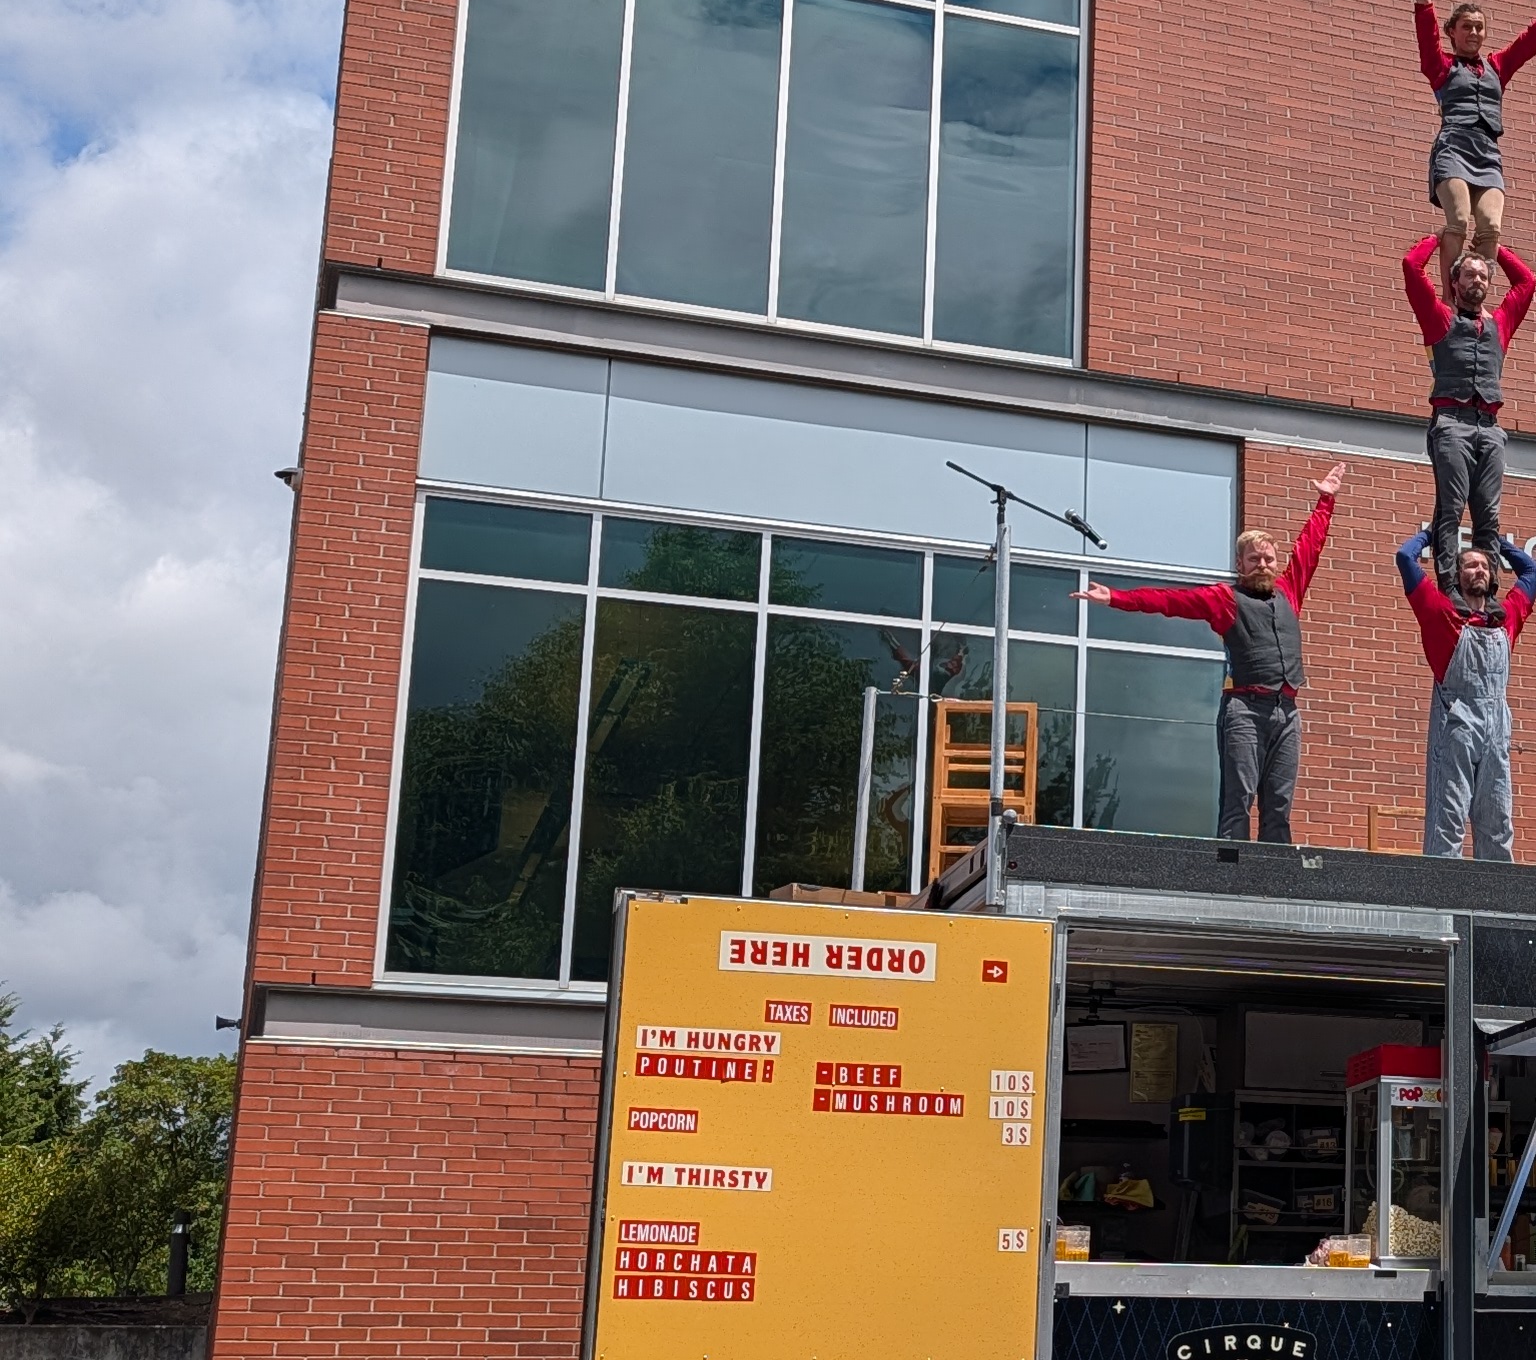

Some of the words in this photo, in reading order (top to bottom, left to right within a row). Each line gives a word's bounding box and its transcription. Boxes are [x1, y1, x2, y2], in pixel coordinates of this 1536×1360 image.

[729, 938, 810, 968] HERE
[826, 944, 926, 974] ORDER
[768, 1003, 809, 1023] TAXES
[832, 1007, 897, 1028] INCLUDED
[641, 1028, 677, 1049] I'M
[687, 1031, 777, 1053] HUNGRY
[994, 1072, 1031, 1092] 10$
[1399, 1086, 1423, 1102] POP
[993, 1097, 1029, 1118] 10$
[630, 1109, 696, 1131] POPCORN
[1004, 1125, 1028, 1145] 3$
[626, 1165, 664, 1185] I'M
[674, 1167, 769, 1190] THIRSTY
[620, 1223, 697, 1243] LEMONADE
[1001, 1230, 1025, 1250] 5$
[619, 1250, 752, 1274] HORCHATA
[617, 1279, 751, 1299] HIBISCUS
[1176, 1335, 1307, 1360] CIRQUE
